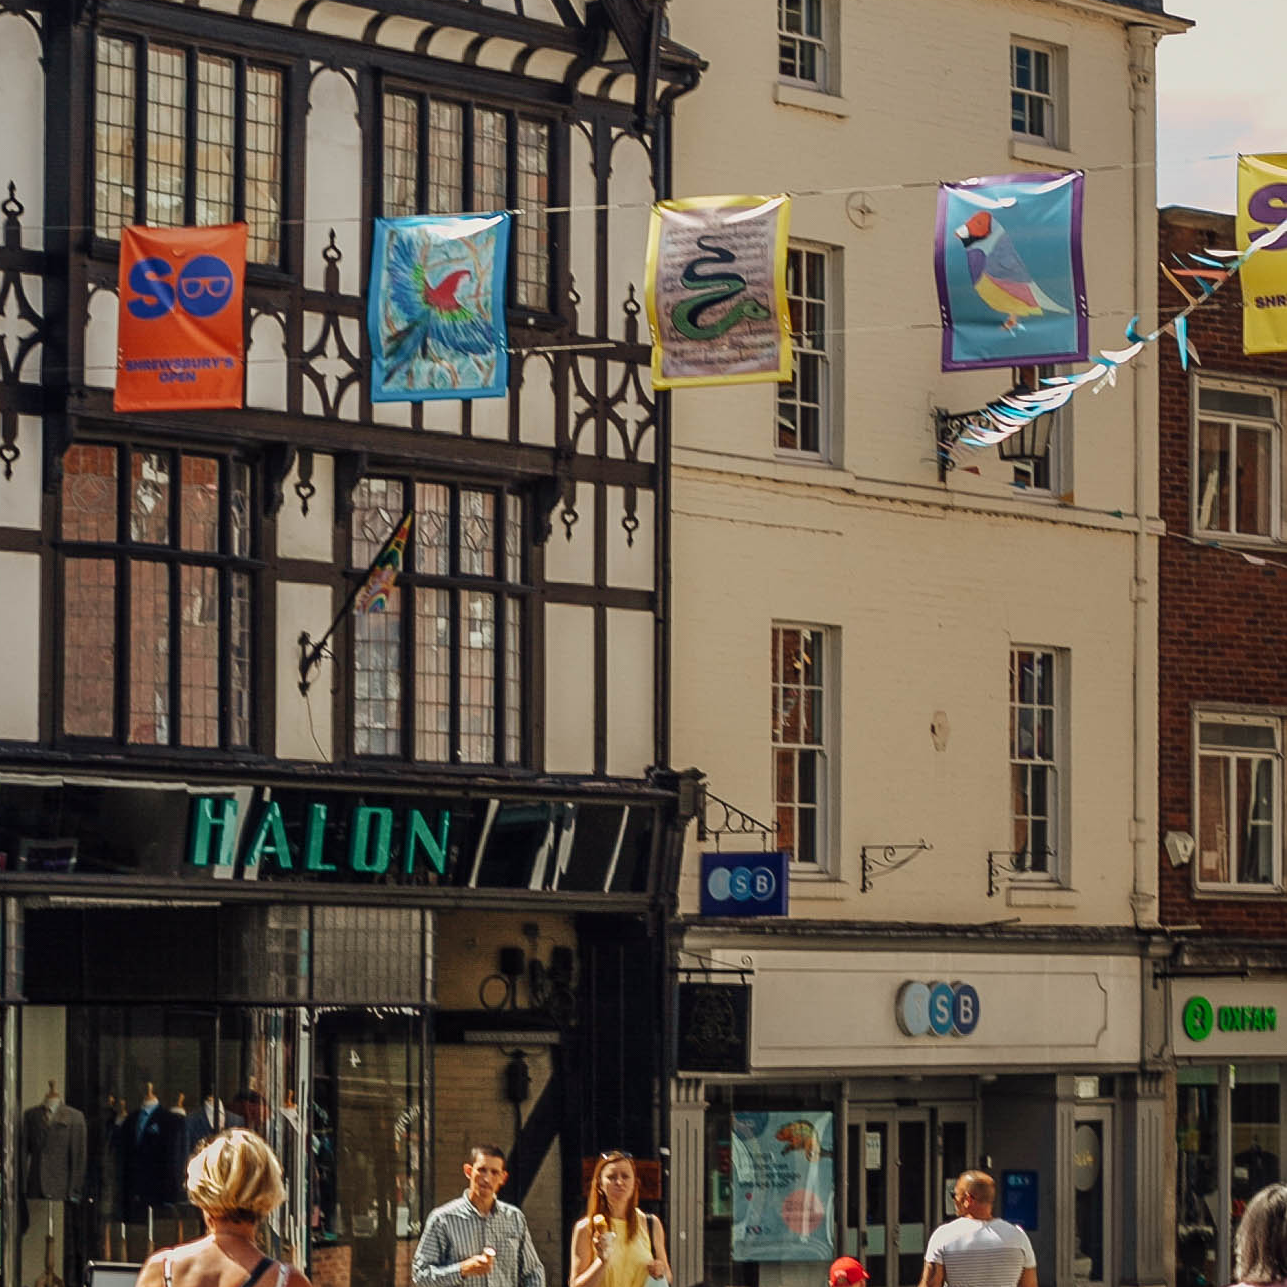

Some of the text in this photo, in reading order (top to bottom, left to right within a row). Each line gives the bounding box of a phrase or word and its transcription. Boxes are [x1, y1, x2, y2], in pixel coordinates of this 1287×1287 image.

[125, 357, 234, 372] SHREWSBURY'S
[159, 370, 197, 383] OPEN
[187, 798, 450, 874] HALON
[1218, 1006, 1277, 1032] OXFAM
